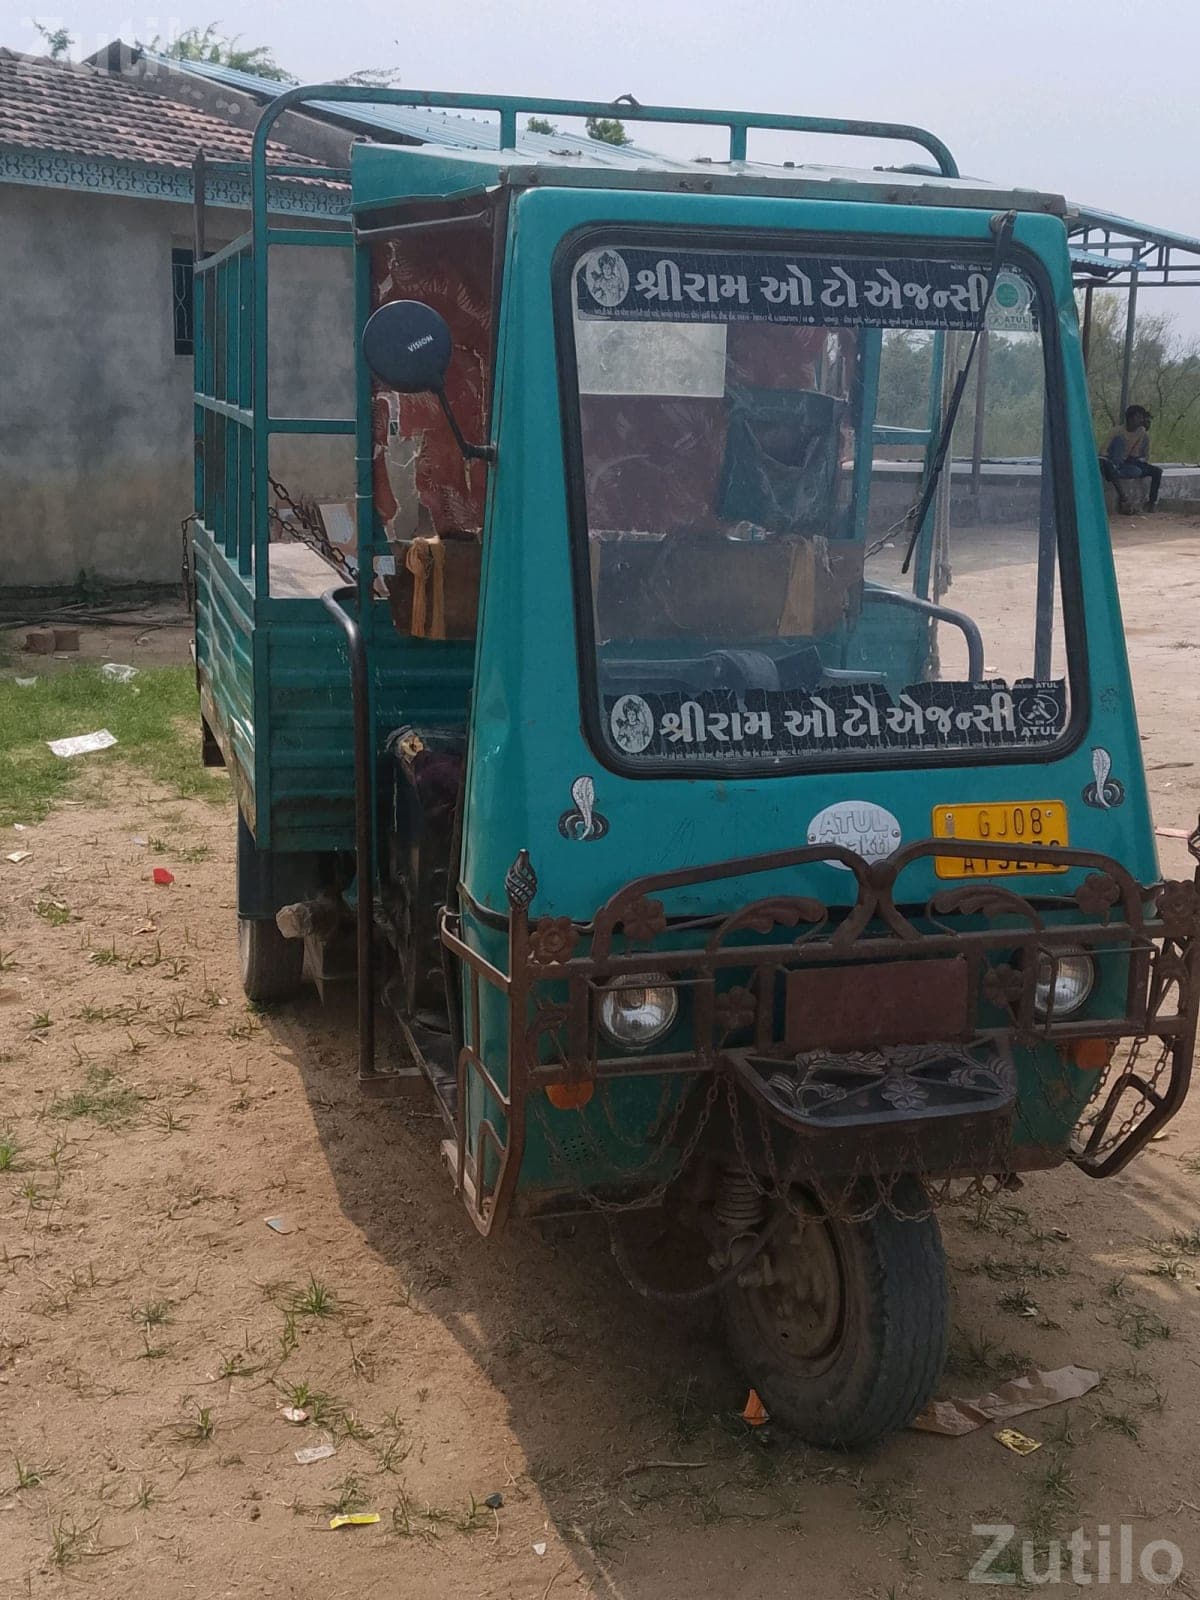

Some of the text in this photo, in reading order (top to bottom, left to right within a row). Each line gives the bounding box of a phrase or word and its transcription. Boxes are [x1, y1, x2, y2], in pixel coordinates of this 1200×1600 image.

[635, 259, 750, 304] શ્રીરામ
[407, 334, 434, 353] VISION
[659, 701, 774, 742] શ્રીરામ
[1020, 726, 1061, 737] ATUL
[820, 810, 889, 835] ATUL
